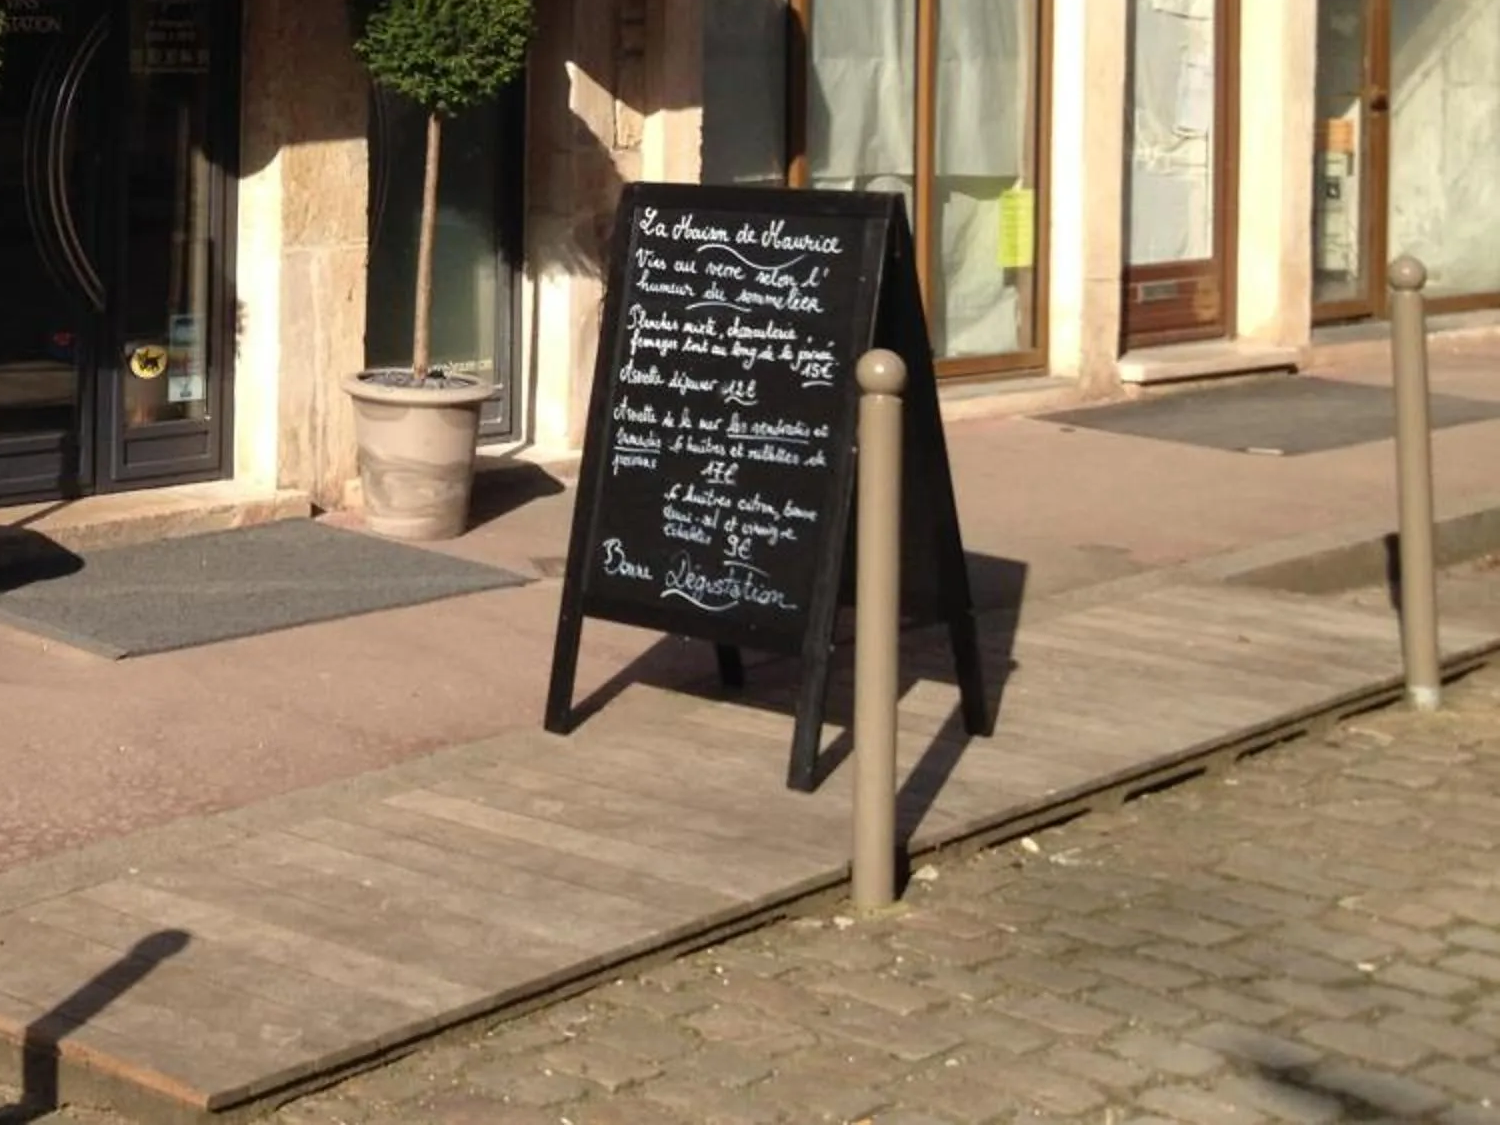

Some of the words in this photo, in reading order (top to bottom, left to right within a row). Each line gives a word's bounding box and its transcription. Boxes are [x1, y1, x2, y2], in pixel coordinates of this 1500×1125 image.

[639, 206, 668, 238] La
[672, 213, 730, 242] Maison
[735, 223, 757, 244] de
[761, 219, 843, 254] Maurice
[673, 258, 697, 274] au
[636, 268, 696, 297] humeur
[703, 281, 727, 302] du
[736, 286, 824, 313] sommelier
